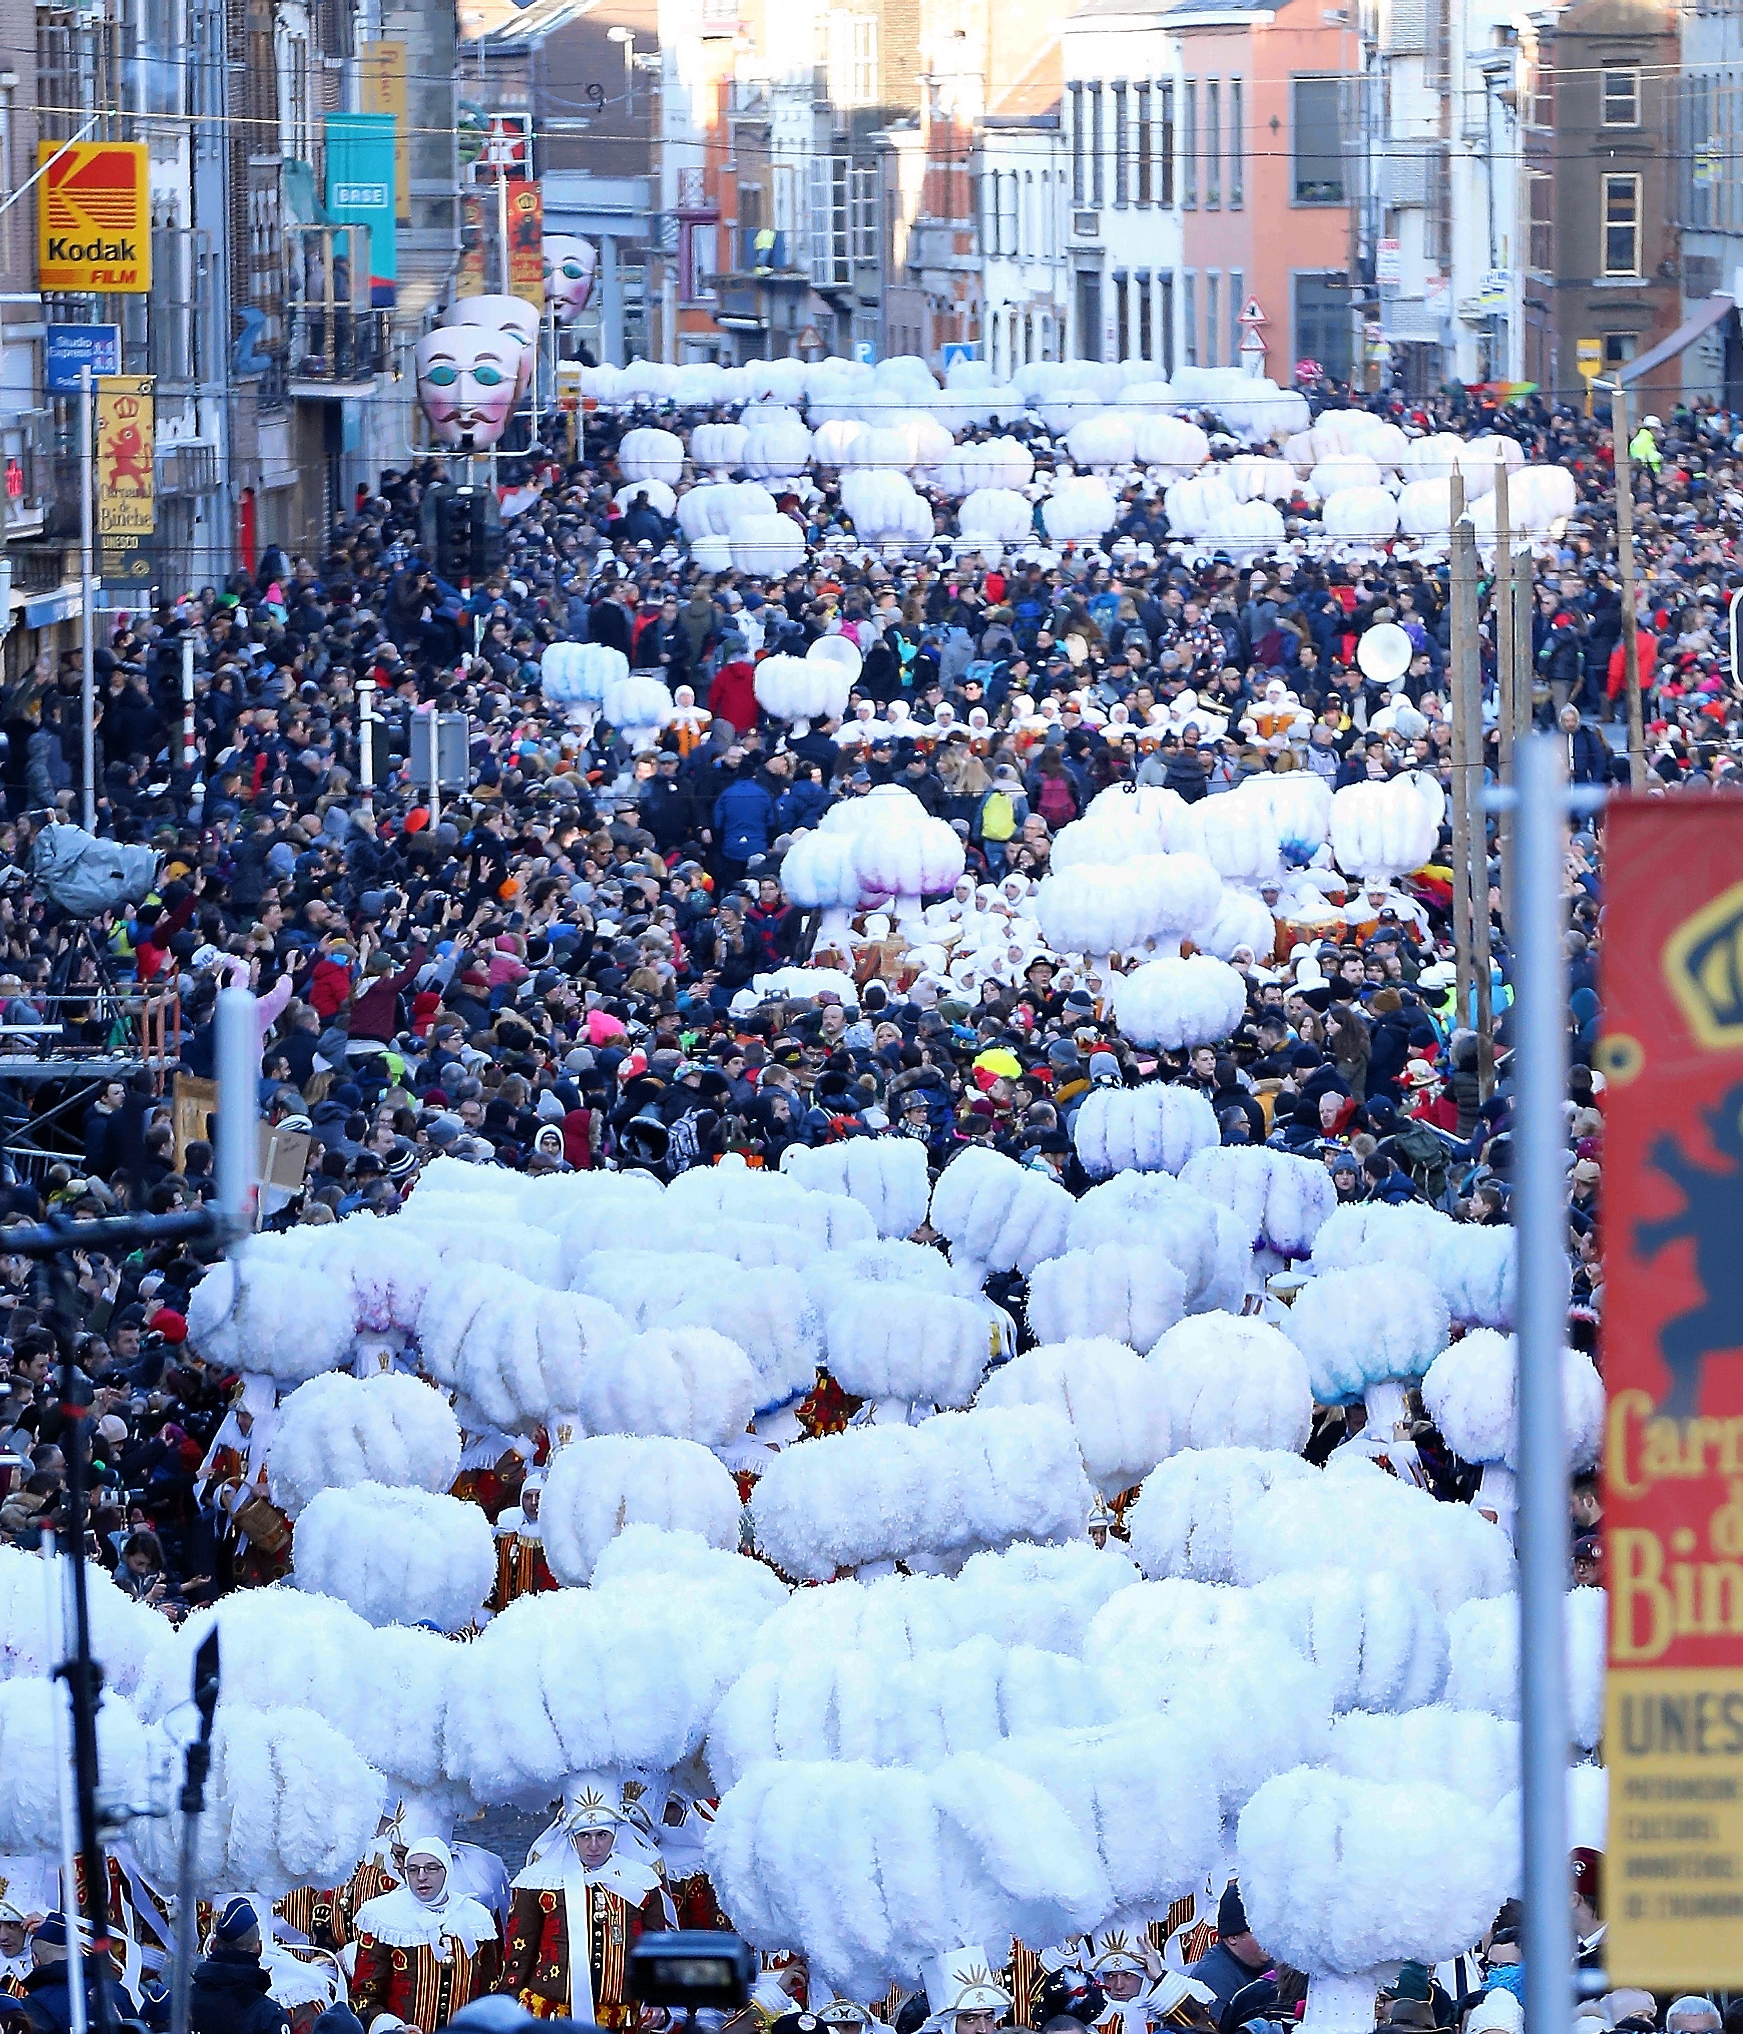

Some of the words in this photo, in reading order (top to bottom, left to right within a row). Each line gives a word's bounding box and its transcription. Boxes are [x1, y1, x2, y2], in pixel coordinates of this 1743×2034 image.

[338, 188, 383, 202] BASE
[48, 237, 137, 261] Kodak
[89, 269, 138, 284] FILM
[100, 508, 152, 530] Binche
[102, 535, 139, 549] UNESCO
[1609, 1526, 1743, 1662] Bin
